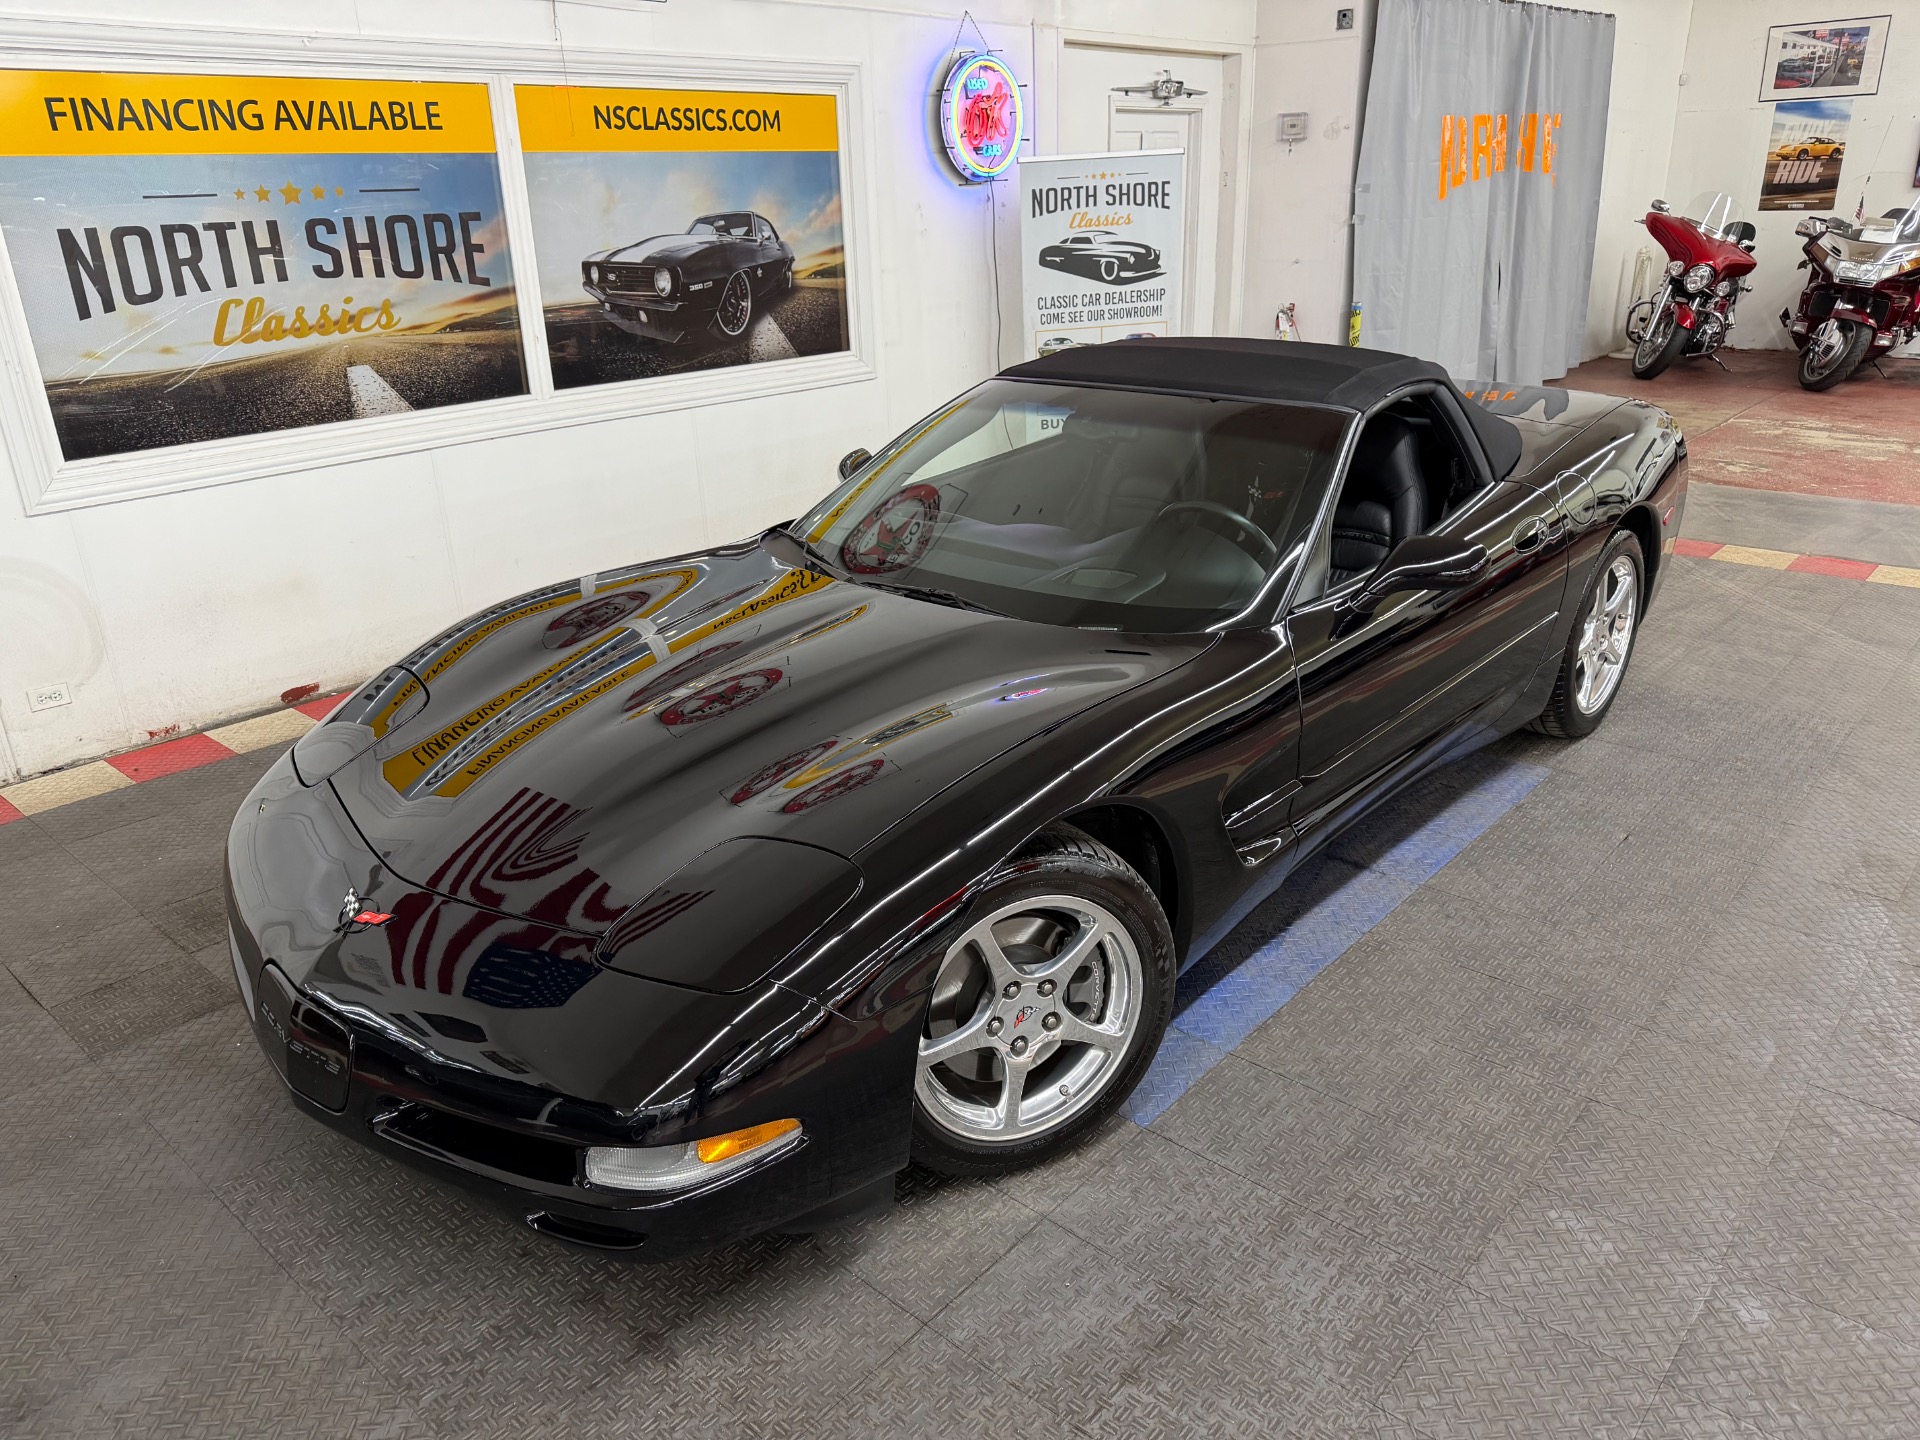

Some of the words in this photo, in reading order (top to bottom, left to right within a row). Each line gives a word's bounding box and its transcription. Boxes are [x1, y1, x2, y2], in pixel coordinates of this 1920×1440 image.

[967, 78, 988, 90] USED
[45, 97, 265, 132] FINANCING
[274, 100, 443, 131] AVAILABLE
[594, 105, 781, 132] NSCLASSICS.COM
[1773, 160, 1827, 184] RIDE
[1031, 184, 1097, 218] NORTH
[1105, 181, 1171, 210] SHORE
[1069, 211, 1133, 229] Classics
[57, 219, 289, 321] NORTH
[305, 212, 491, 287] SHORE
[1037, 294, 1078, 311] CLASSIC
[1081, 293, 1101, 307] CAR
[1104, 288, 1166, 305] DEALERSHIP
[213, 296, 402, 347] Classics
[1040, 312, 1065, 325] COME
[1068, 310, 1084, 323] SEE
[1087, 309, 1105, 322] OUR
[1107, 305, 1162, 320] SHOWROOM!
